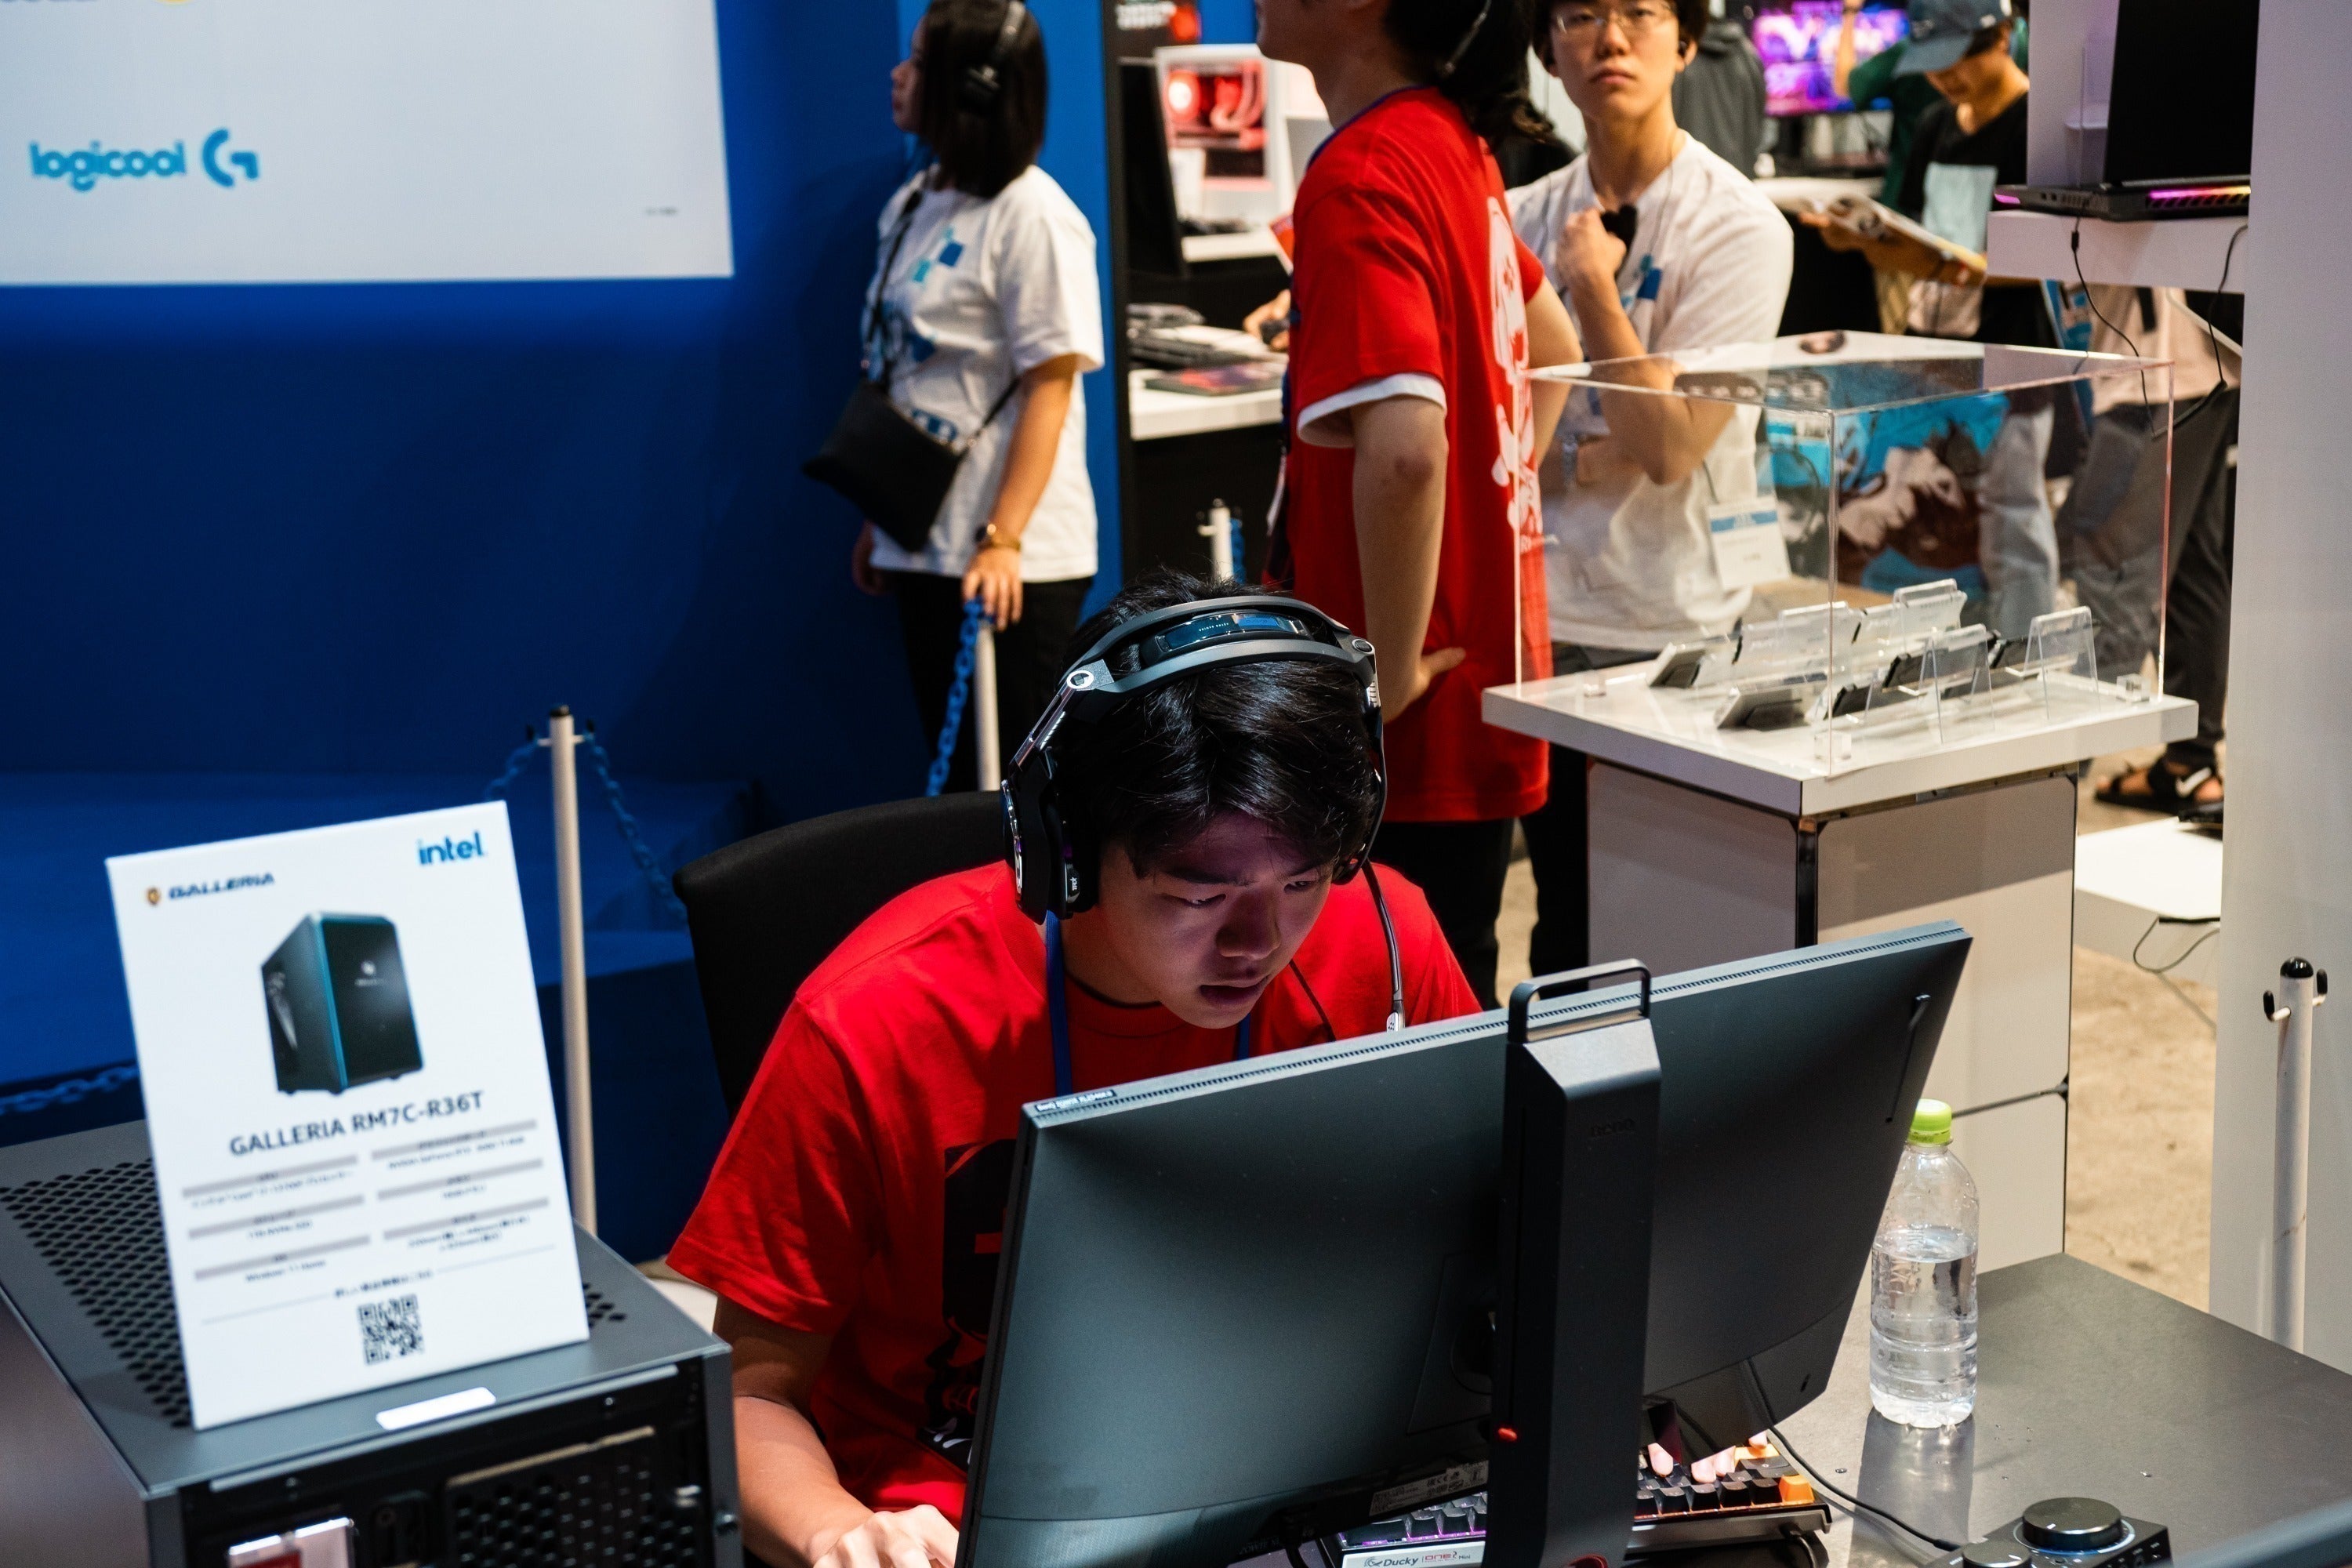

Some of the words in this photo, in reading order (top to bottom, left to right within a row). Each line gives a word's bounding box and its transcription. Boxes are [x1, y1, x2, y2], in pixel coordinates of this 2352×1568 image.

[29, 140, 187, 192] logicool
[416, 830, 483, 865] intel
[169, 872, 275, 899] GALLERIA
[230, 1116, 346, 1156] GALLERIA
[351, 1091, 483, 1134] RM7C-R36T
[1383, 1557, 1419, 1566] Ducky
